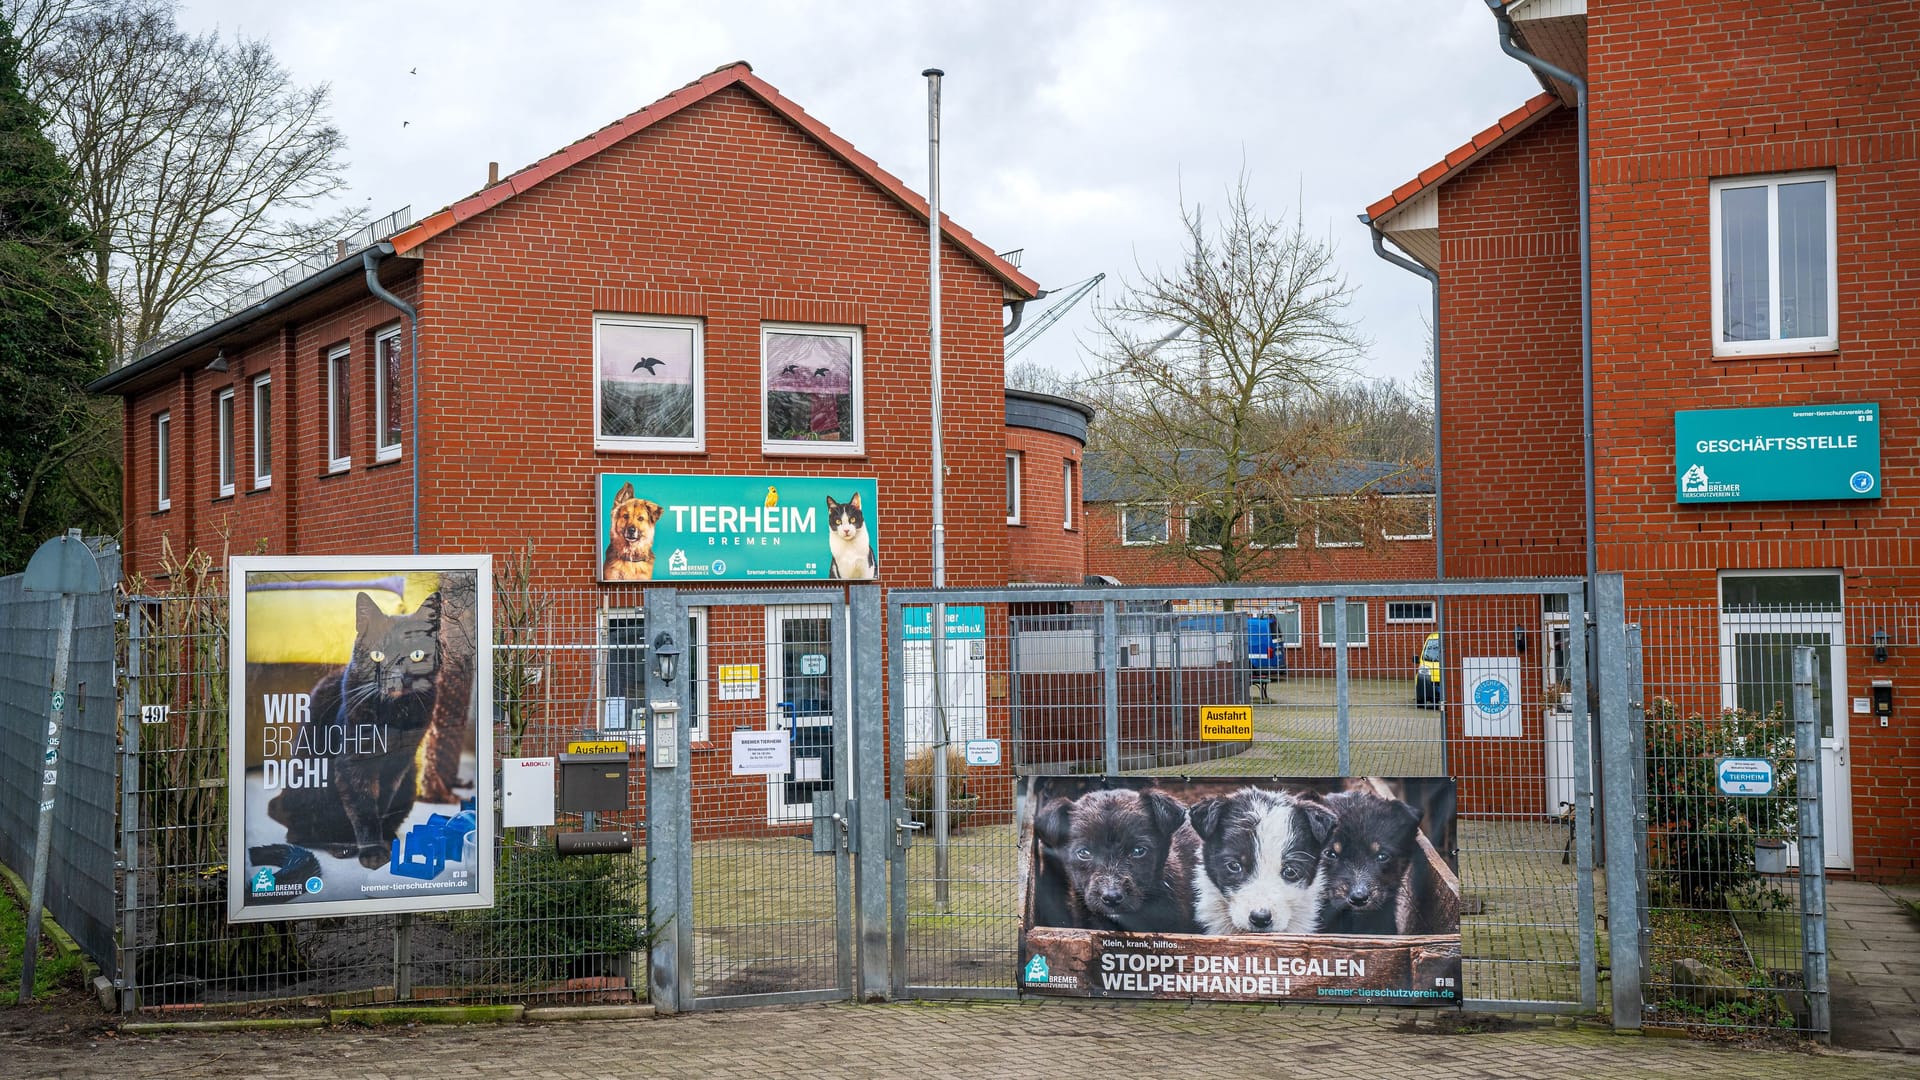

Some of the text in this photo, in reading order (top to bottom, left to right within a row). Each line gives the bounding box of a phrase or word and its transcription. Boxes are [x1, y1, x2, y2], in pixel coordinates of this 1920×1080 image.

[1792, 409, 1873, 418] bremer-tierschutzverein.de
[1696, 435, 1858, 453] GESCHÄFTSSTELLE
[1708, 484, 1740, 492] BREMER
[669, 505, 816, 533] TIERHEIM
[708, 536, 781, 546] BREMEN
[144, 706, 166, 722] 491
[263, 693, 311, 724] WIR
[1206, 711, 1247, 720] Ausfahrt
[1203, 725, 1250, 734] freihalten
[263, 723, 388, 757] BRAUCHEN
[575, 745, 619, 754] Ausfahrt
[263, 757, 329, 790] DICH!
[573, 841, 619, 849] ZEITUNGEN
[275, 884, 303, 892] BREMER
[361, 879, 468, 892] bremer-tierschutzverein.de
[1102, 940, 1124, 949] Klein,
[1126, 940, 1151, 950] krank,
[1101, 953, 1365, 977] STOPPT DEN ILLEGALEN
[1048, 975, 1078, 983] BREMER
[1102, 973, 1291, 995] WELPENHANDEL!
[1317, 986, 1455, 999] bremer-tierschutzverein.de
